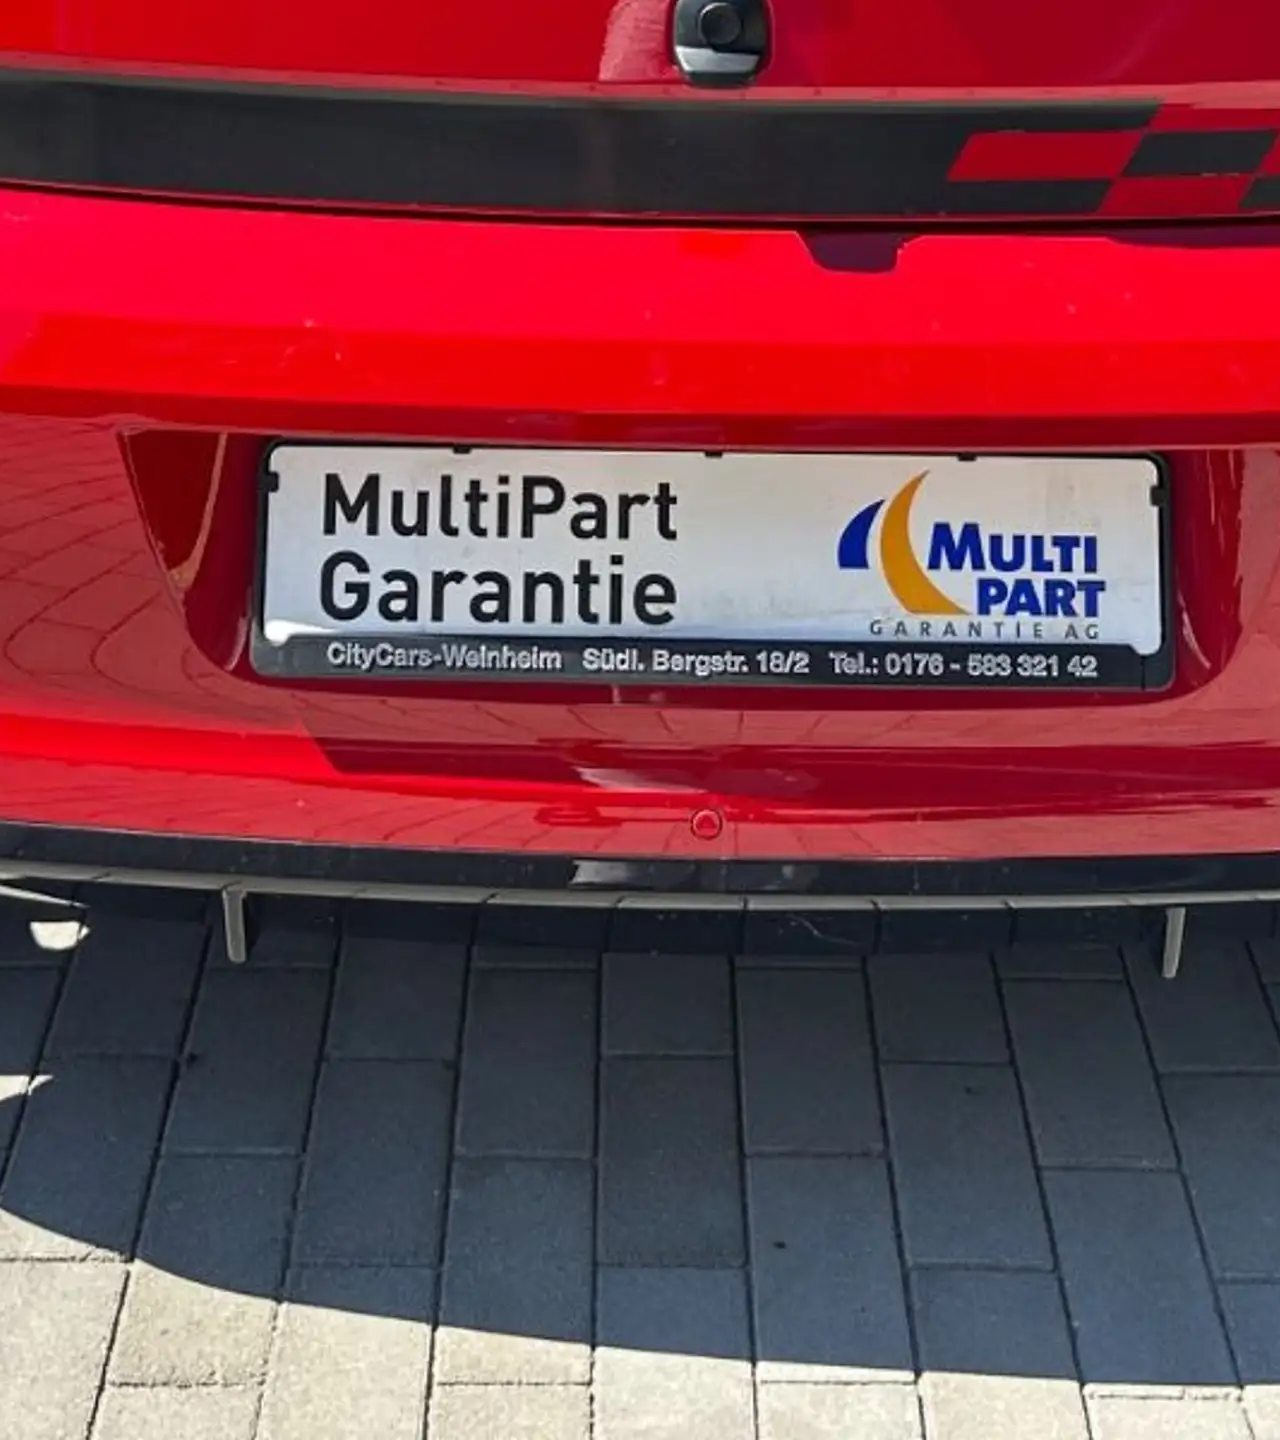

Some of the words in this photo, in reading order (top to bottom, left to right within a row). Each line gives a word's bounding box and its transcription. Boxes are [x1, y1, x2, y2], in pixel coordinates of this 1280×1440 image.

[323, 473, 678, 540] MultiPart
[320, 550, 677, 625] Garantie
[977, 577, 1106, 617] PART
[870, 619, 1045, 639] GARANTIE
[1064, 624, 1100, 640] AG
[327, 641, 562, 671] CityCars-Weinheim
[582, 647, 646, 672] Südl.
[652, 649, 750, 678] Bergstr.
[756, 650, 810, 674] 18/2
[828, 652, 880, 676] Tel.:
[886, 653, 944, 677] 0176
[1017, 655, 1061, 678] 321
[1067, 656, 1098, 678] 42
